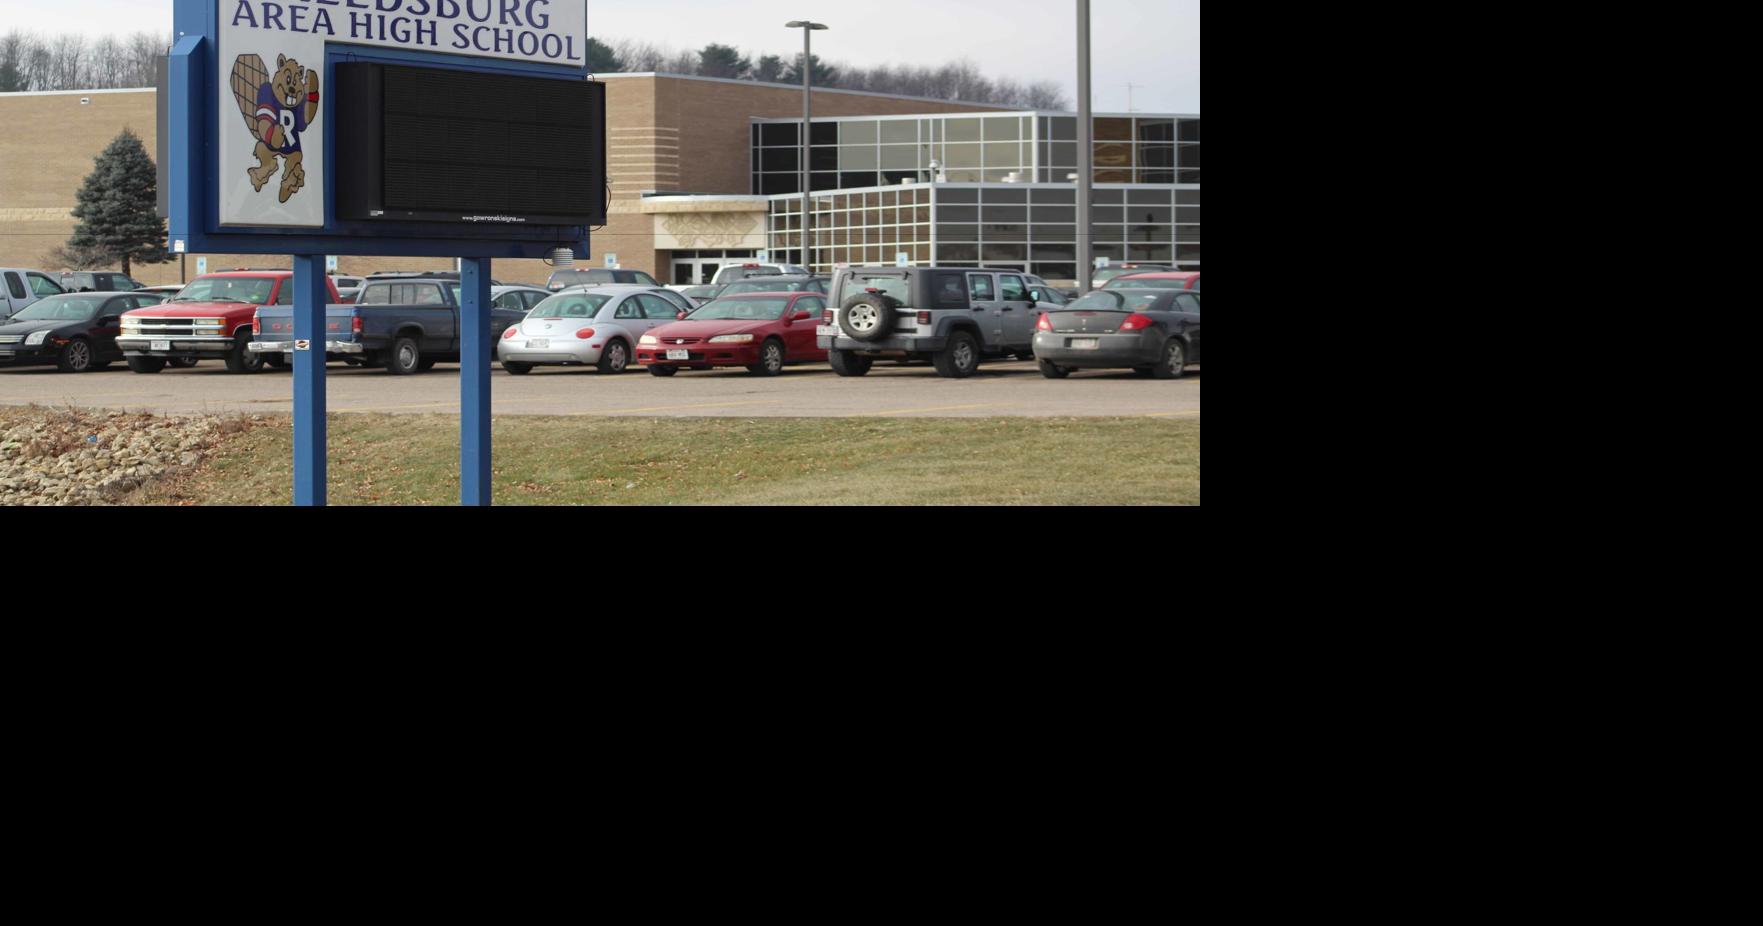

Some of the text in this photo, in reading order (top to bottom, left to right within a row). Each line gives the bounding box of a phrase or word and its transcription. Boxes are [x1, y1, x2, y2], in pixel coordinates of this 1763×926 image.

[232, 0, 581, 60] AREA HIGH SCHOOL
[299, 0, 549, 30] SBURG
[280, 109, 296, 147] R
